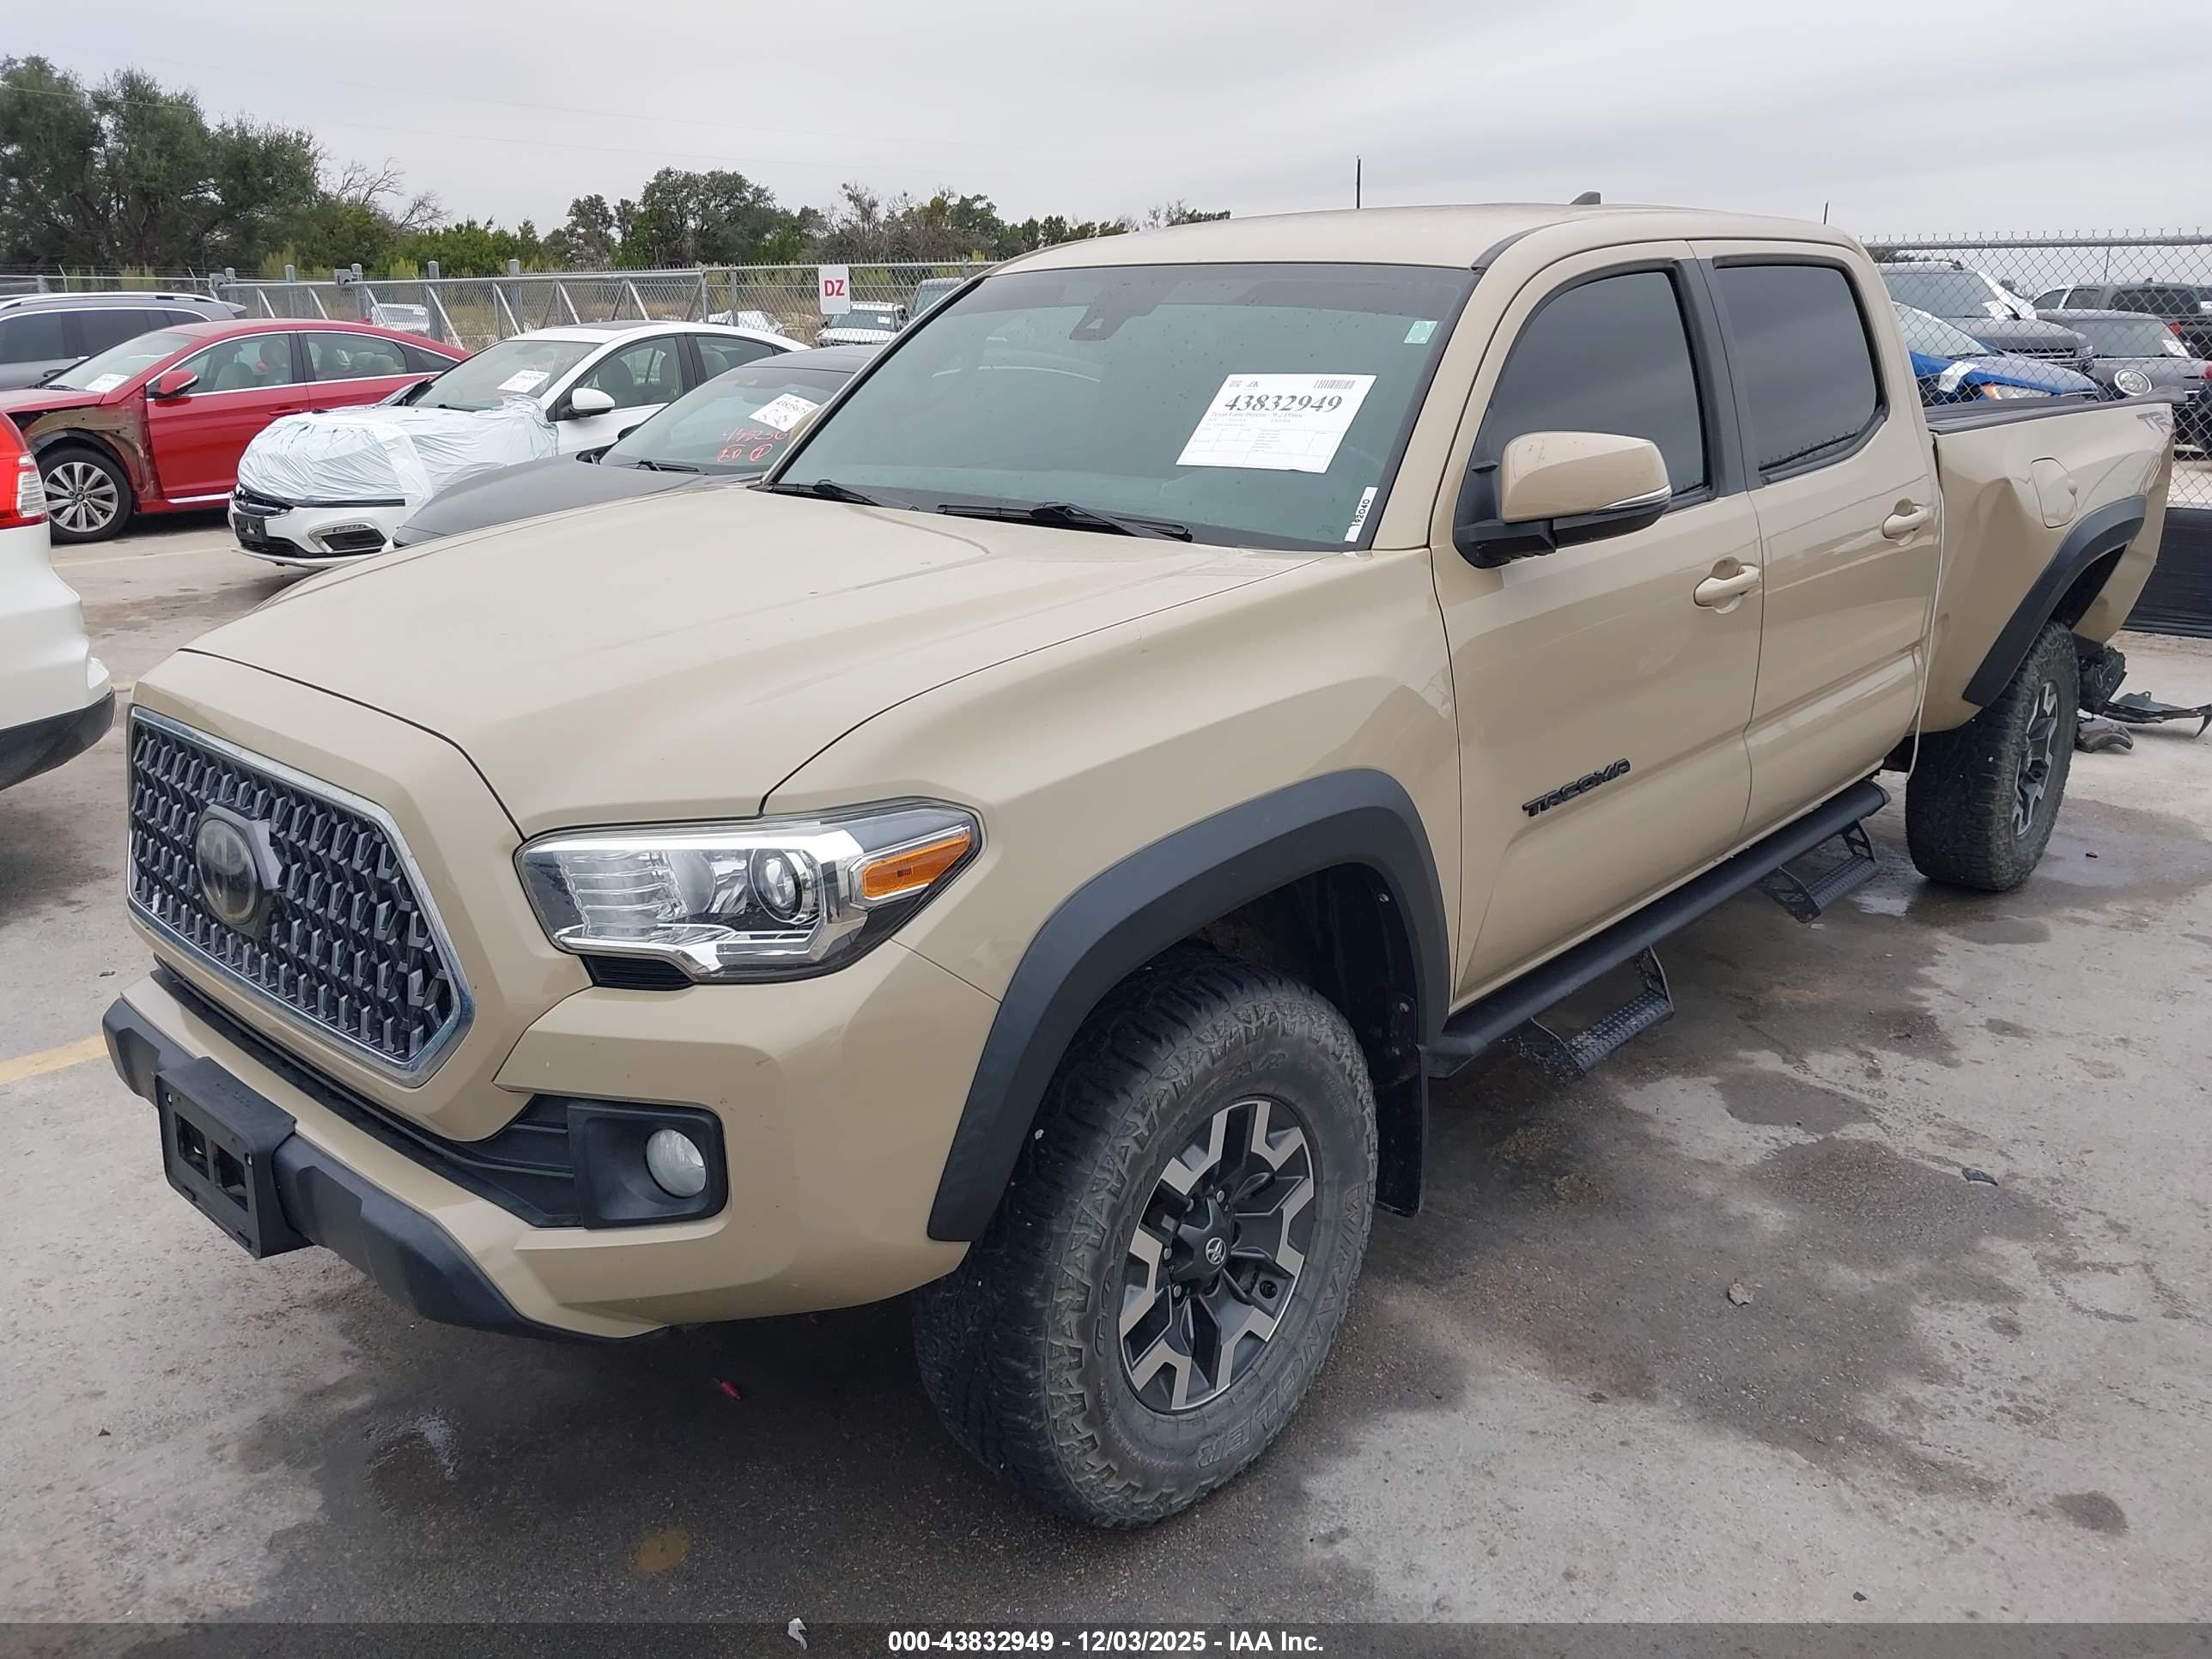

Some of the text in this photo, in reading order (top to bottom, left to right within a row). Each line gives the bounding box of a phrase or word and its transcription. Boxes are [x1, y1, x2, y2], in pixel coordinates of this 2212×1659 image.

[823, 279, 846, 296] DZ
[1224, 394, 1342, 412] 43832949
[1522, 757, 1632, 817] TACOMA
